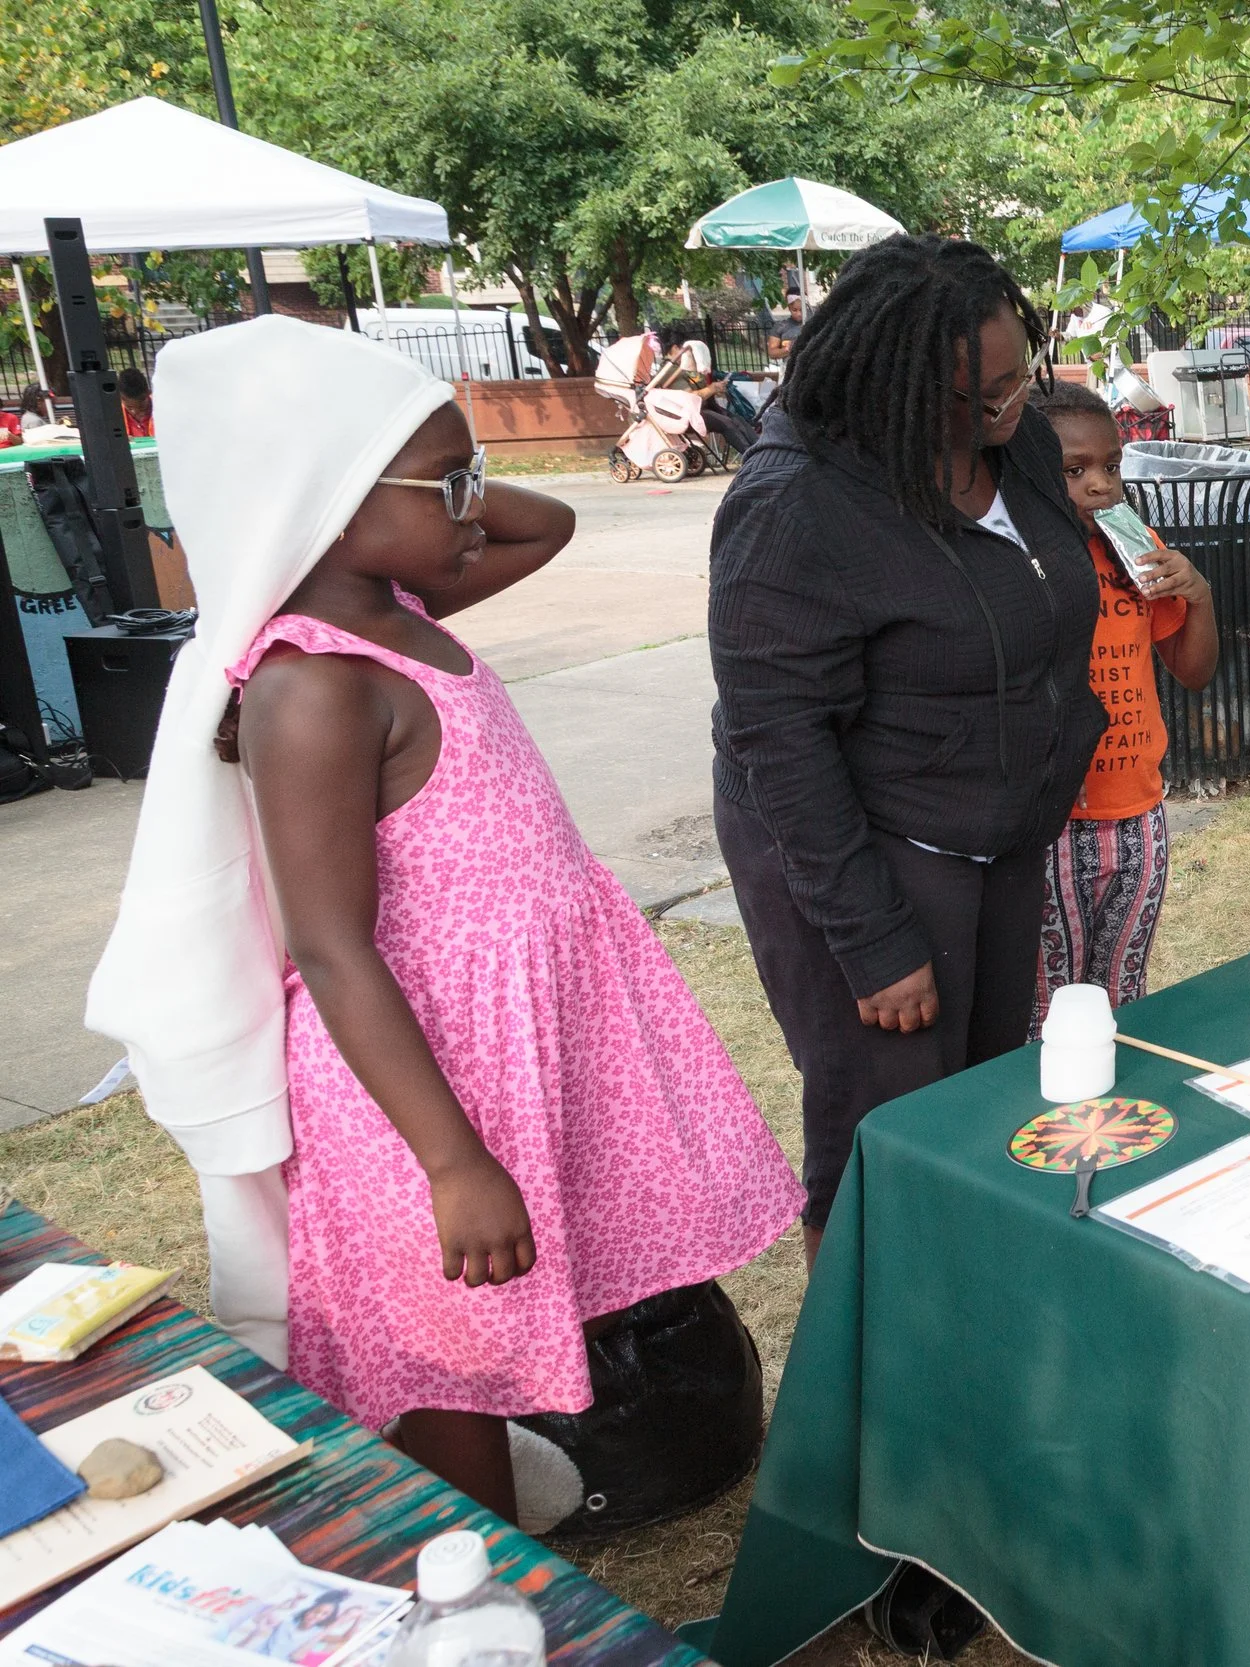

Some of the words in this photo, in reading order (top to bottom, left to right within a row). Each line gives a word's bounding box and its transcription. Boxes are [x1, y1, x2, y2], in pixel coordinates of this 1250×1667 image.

[820, 231, 847, 242] Catch
[1105, 731, 1151, 750] FAITH
[1096, 754, 1139, 773] RITY
